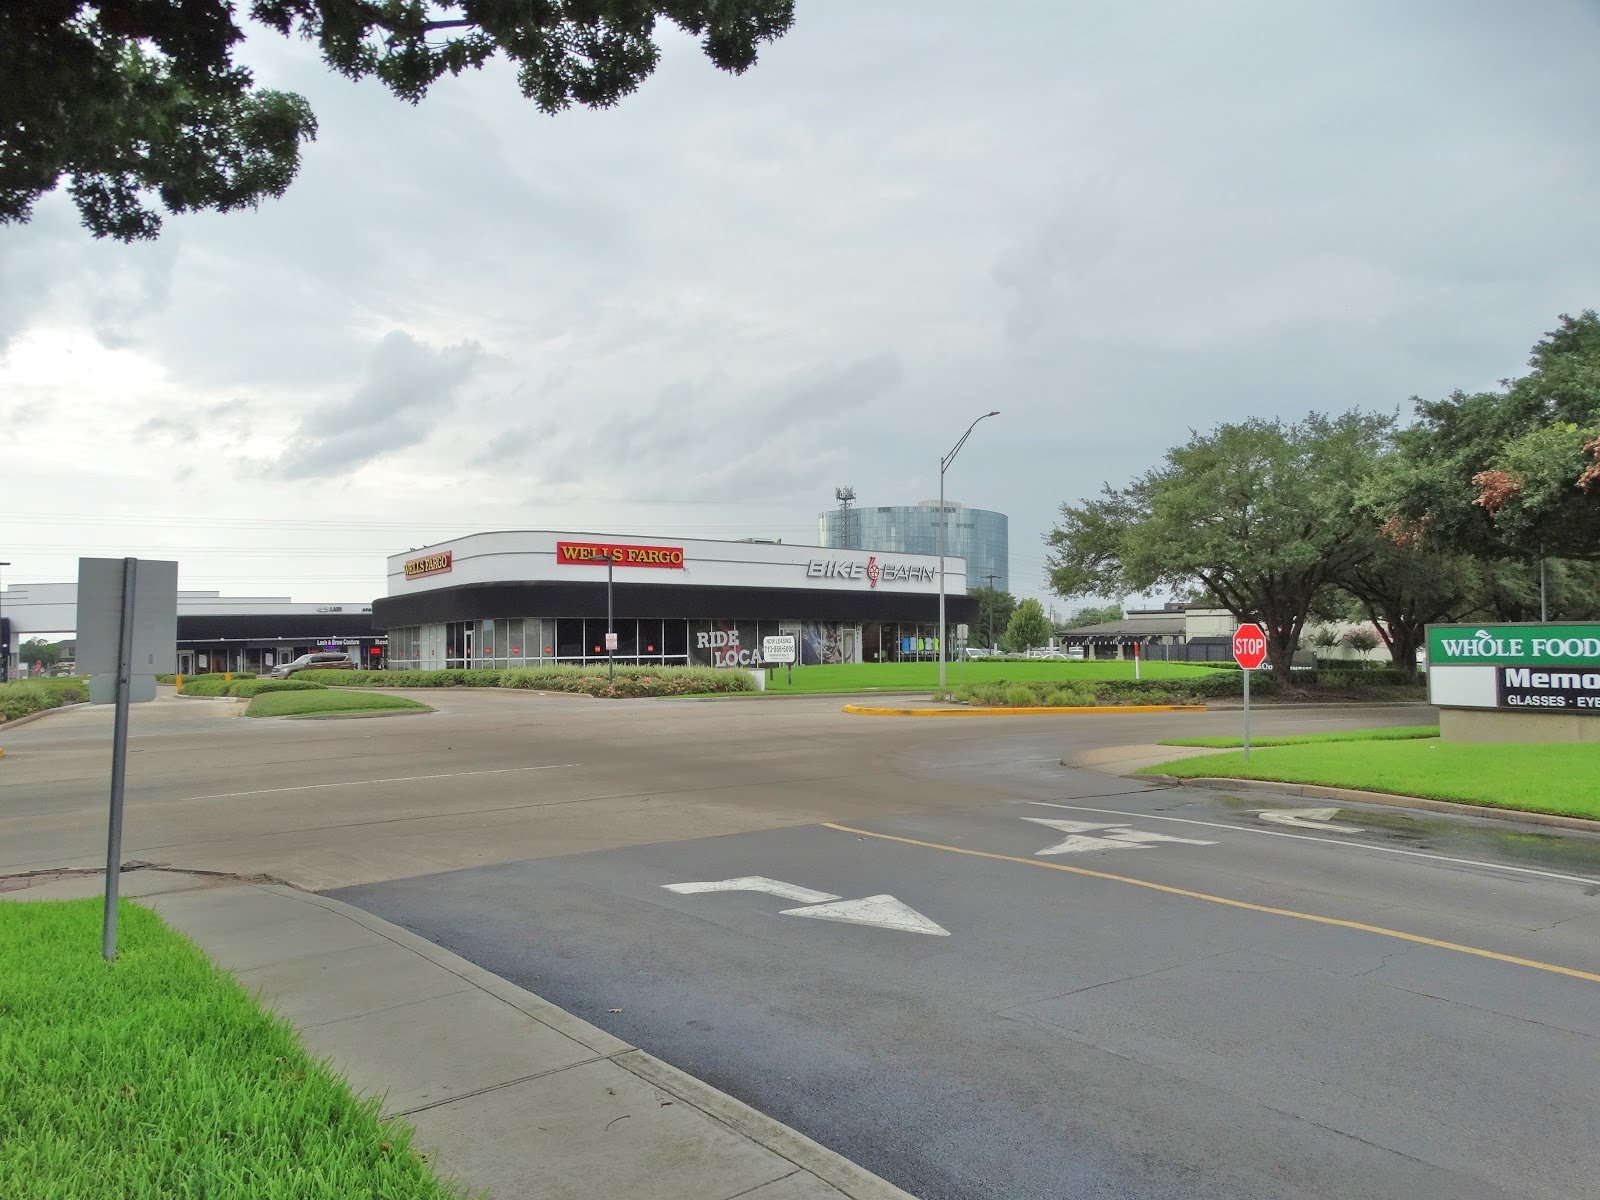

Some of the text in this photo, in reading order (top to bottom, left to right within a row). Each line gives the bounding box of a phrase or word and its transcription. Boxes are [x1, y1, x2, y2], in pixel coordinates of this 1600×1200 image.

[561, 546, 683, 564] WELLS FARGO
[404, 555, 448, 576] WELLS FARGO
[807, 560, 935, 582] BIKE BARN
[696, 630, 740, 648] RIDE
[1235, 638, 1263, 655] STOP
[1440, 632, 1525, 657] WHOLE
[714, 648, 767, 667] LOCA
[1507, 695, 1566, 707] GLASSES
